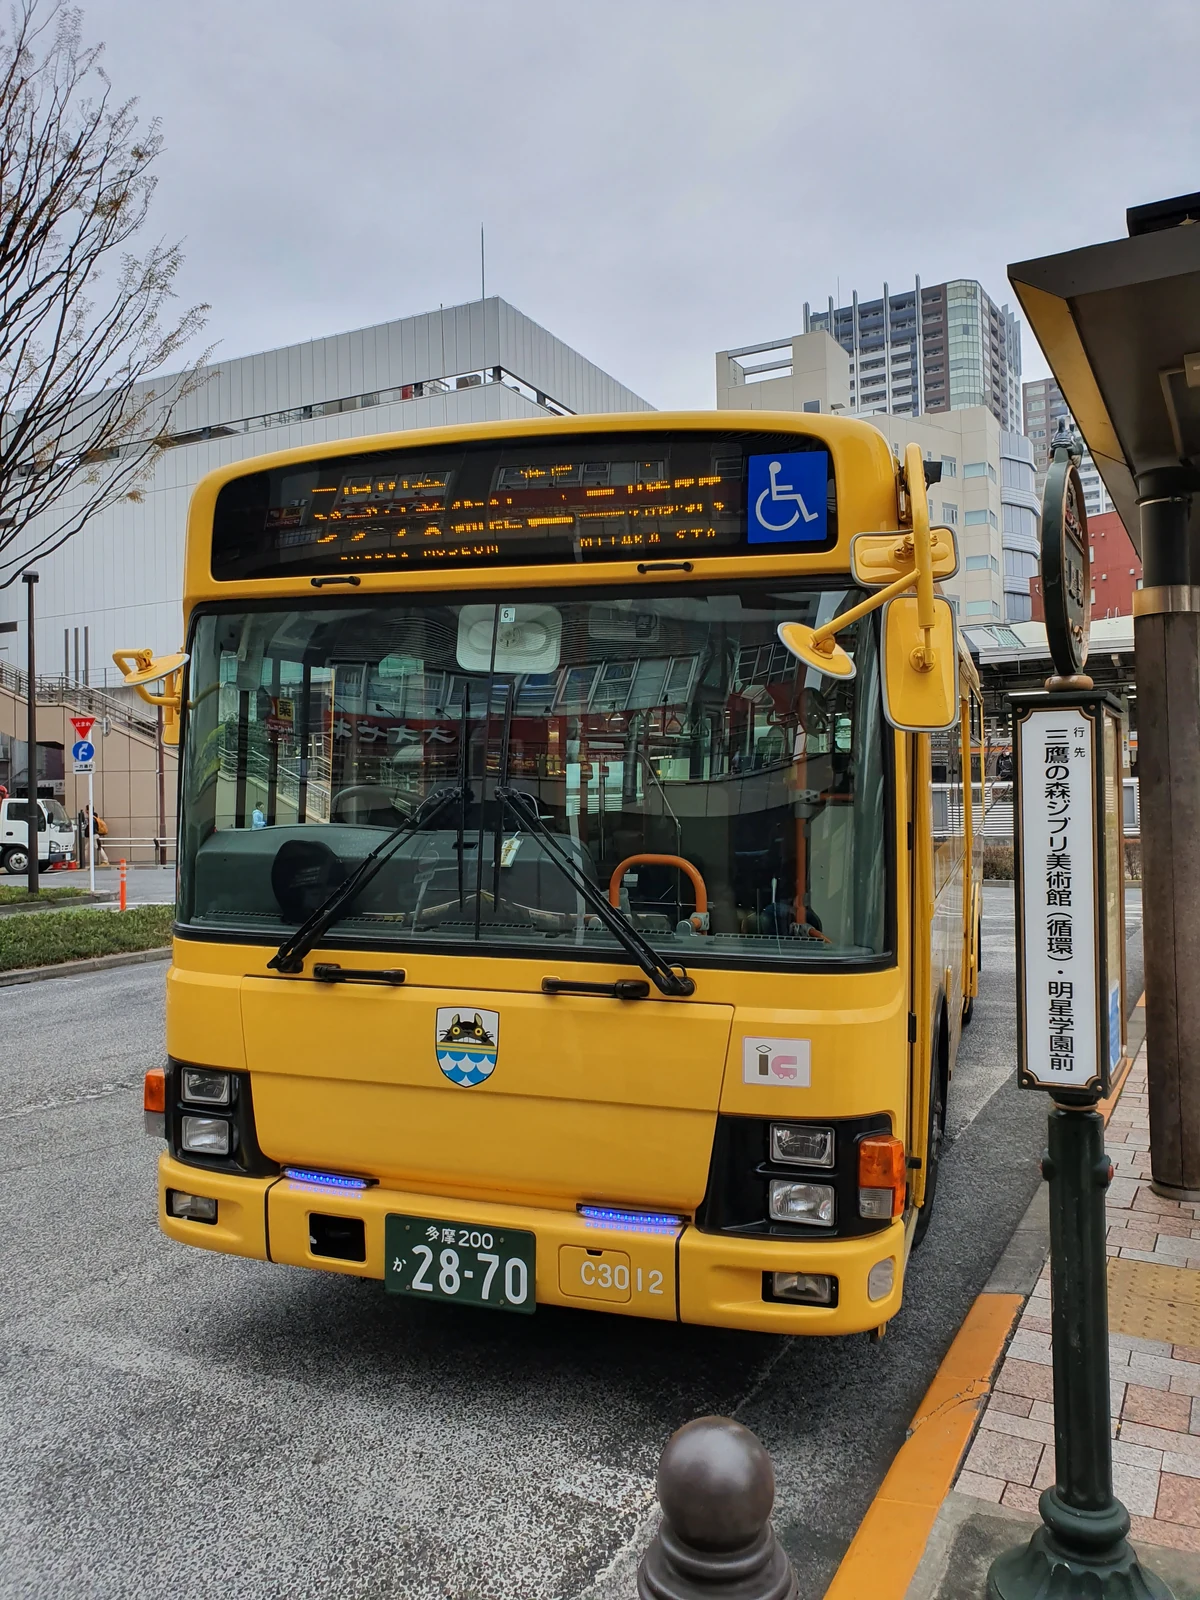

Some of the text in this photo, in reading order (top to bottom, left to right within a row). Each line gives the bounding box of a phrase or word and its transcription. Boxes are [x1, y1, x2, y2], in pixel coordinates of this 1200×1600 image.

[392, 1256, 407, 1272] か
[411, 1244, 528, 1305] 28-70
[580, 1260, 664, 1295] C3012
